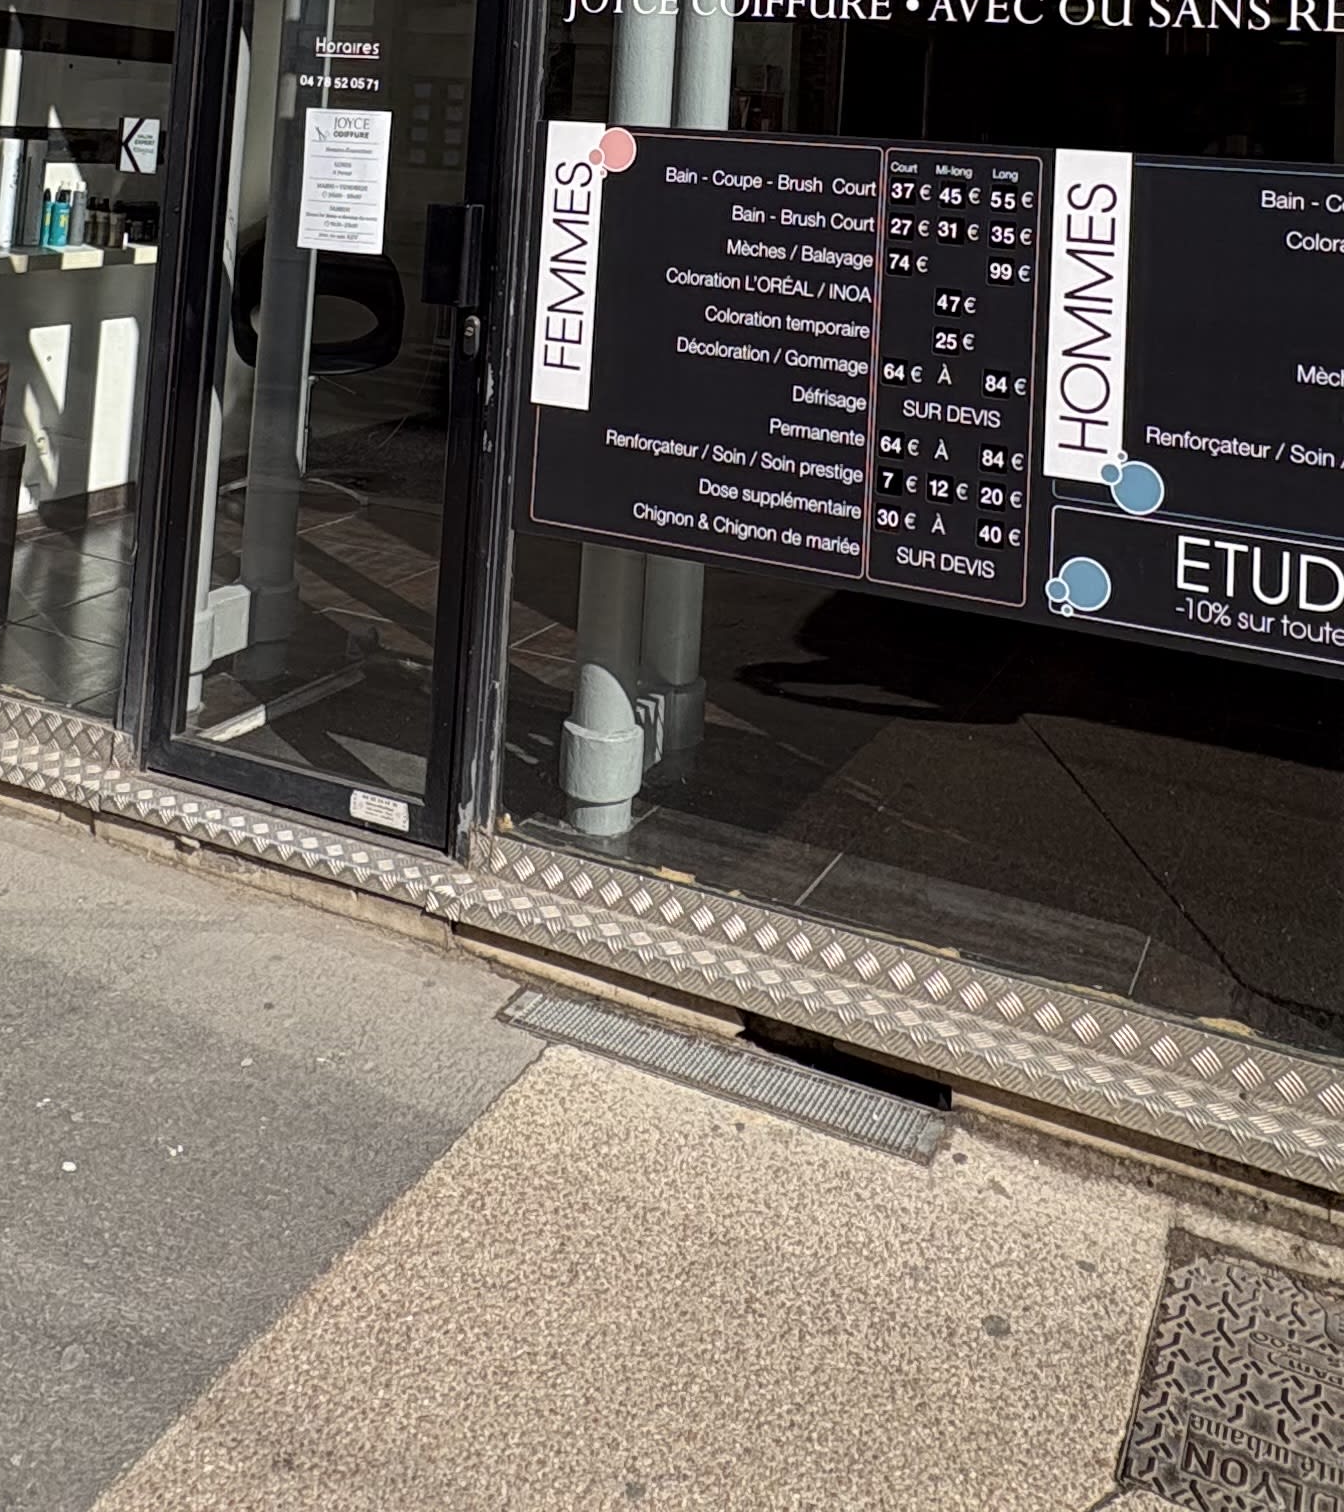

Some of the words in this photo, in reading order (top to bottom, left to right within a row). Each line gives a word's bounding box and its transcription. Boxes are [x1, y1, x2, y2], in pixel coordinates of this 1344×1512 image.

[315, 36, 380, 55] Horaires
[299, 74, 315, 87] 04
[333, 76, 349, 89] 52
[333, 116, 370, 131] JOYCE
[333, 129, 370, 140] COIFFURE
[665, 166, 698, 184] Bain
[712, 169, 763, 191] Coupe
[777, 173, 823, 193] Brush
[831, 177, 877, 197] Court
[890, 161, 918, 174] Court
[935, 164, 973, 180] Mi-long
[992, 168, 1019, 183] Long
[891, 182, 915, 199] 37
[938, 187, 962, 205] 45
[990, 191, 1016, 210] 55
[1261, 189, 1305, 211] Bain
[731, 204, 766, 223] Bain
[780, 208, 826, 228] Brush
[830, 212, 875, 233] Court
[890, 217, 913, 236] 27
[937, 220, 958, 239] 31
[991, 225, 1015, 245] 35
[544, 160, 593, 372] FEMMES
[726, 238, 787, 260] Mèches
[801, 245, 874, 271] Balayage
[888, 253, 910, 271] 74
[989, 262, 1013, 281] 99
[665, 267, 741, 290] Coloration
[744, 275, 815, 298] L'ORÉAL
[829, 283, 872, 304] INOA
[936, 293, 961, 313] 47
[1058, 182, 1118, 454] HOMMES
[704, 305, 782, 329] Coloration
[785, 314, 871, 339] temporaire
[935, 331, 958, 351] 25
[676, 336, 770, 363] Décoloration
[784, 349, 869, 378] Gommage
[883, 362, 905, 381] 64
[984, 374, 1008, 393] 84
[792, 385, 867, 413] Défrisage
[902, 399, 942, 421] SUR
[946, 404, 1001, 429] DEVIS
[769, 417, 866, 447] Permanente
[1146, 425, 1272, 459] Renforçateur
[1289, 444, 1335, 468] Soin
[605, 428, 699, 458] Renforçateur
[711, 444, 746, 466] Soin
[760, 452, 796, 473] Soin
[799, 461, 864, 486] prestige
[880, 435, 902, 454] 64
[981, 449, 1005, 469] 84
[698, 478, 739, 500] Dose
[741, 488, 862, 520] supplémentaire
[882, 471, 894, 489] 7
[929, 479, 949, 498] 12
[980, 486, 1004, 506] 20
[633, 502, 694, 528] Chignon
[697, 512, 710, 531] &
[712, 515, 777, 542] Chignon
[781, 527, 802, 546] de
[805, 535, 861, 556] mariée
[876, 508, 899, 528] 30
[978, 525, 1002, 544] 40
[896, 546, 936, 569] SUR
[940, 553, 995, 579] DEVIS
[1175, 597, 1232, 627] -10%
[1237, 611, 1276, 634] sur
[1188, 1413, 1291, 1466] urbaine
